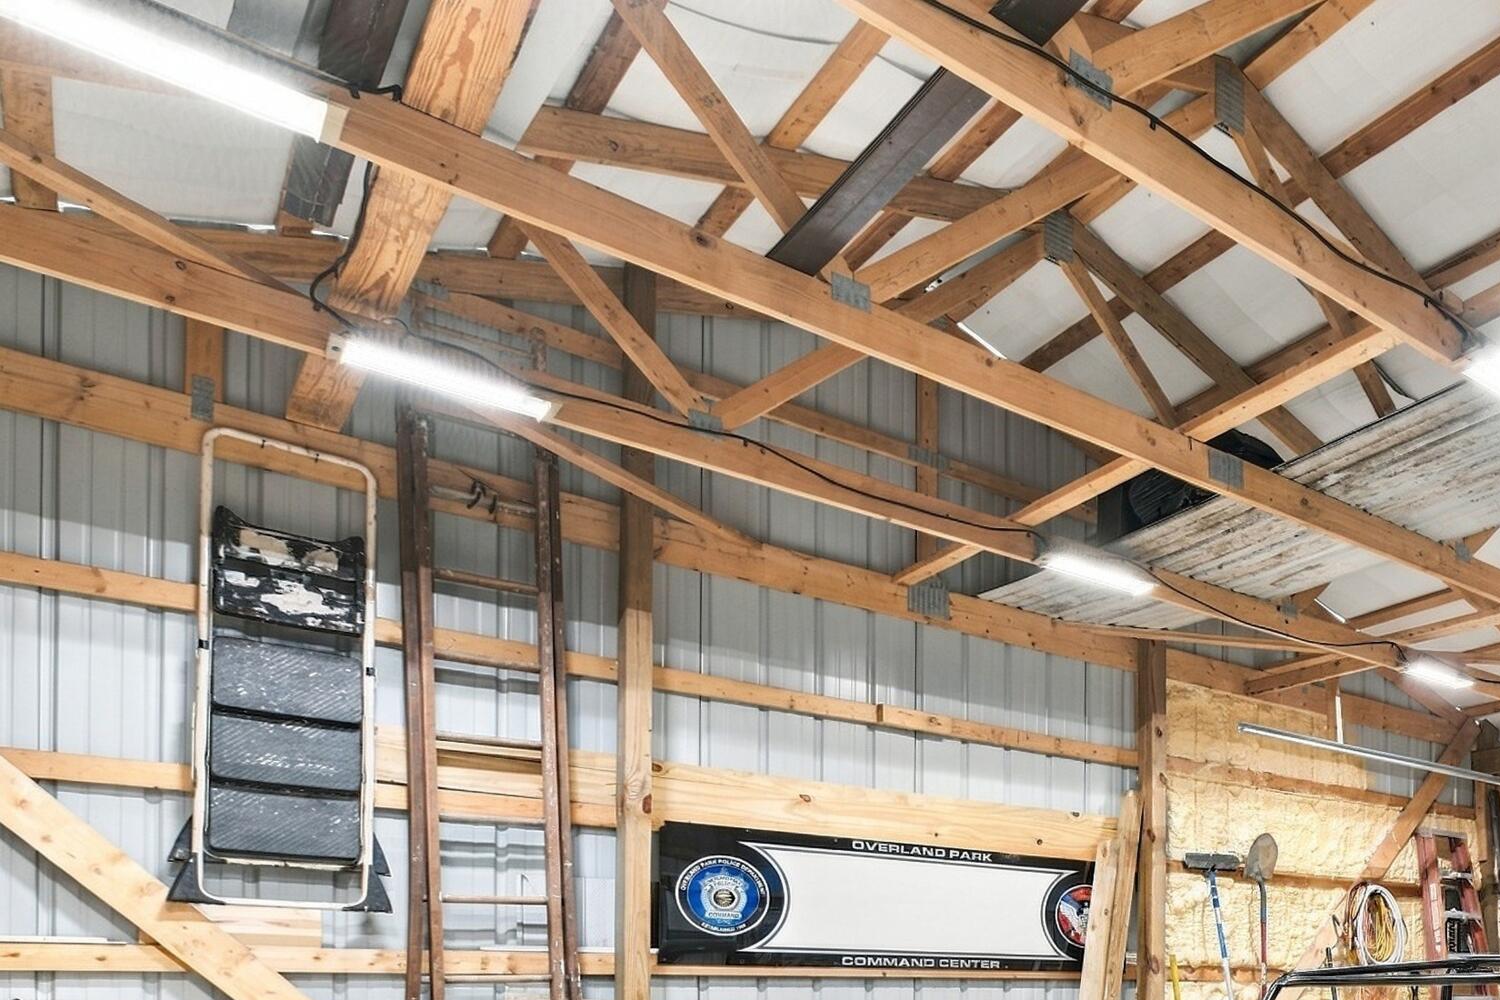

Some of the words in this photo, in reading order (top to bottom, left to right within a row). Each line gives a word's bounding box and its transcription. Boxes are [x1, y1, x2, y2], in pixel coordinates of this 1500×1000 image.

[851, 840, 946, 858] OVERLAND
[949, 849, 993, 863] PARK
[700, 859, 717, 868] PARK
[718, 859, 740, 868] POLICE
[741, 864, 766, 895] DEPARTMENT
[708, 911, 740, 919] COMMAND
[841, 956, 936, 968] COMMAND
[939, 958, 1000, 969] CENTER
